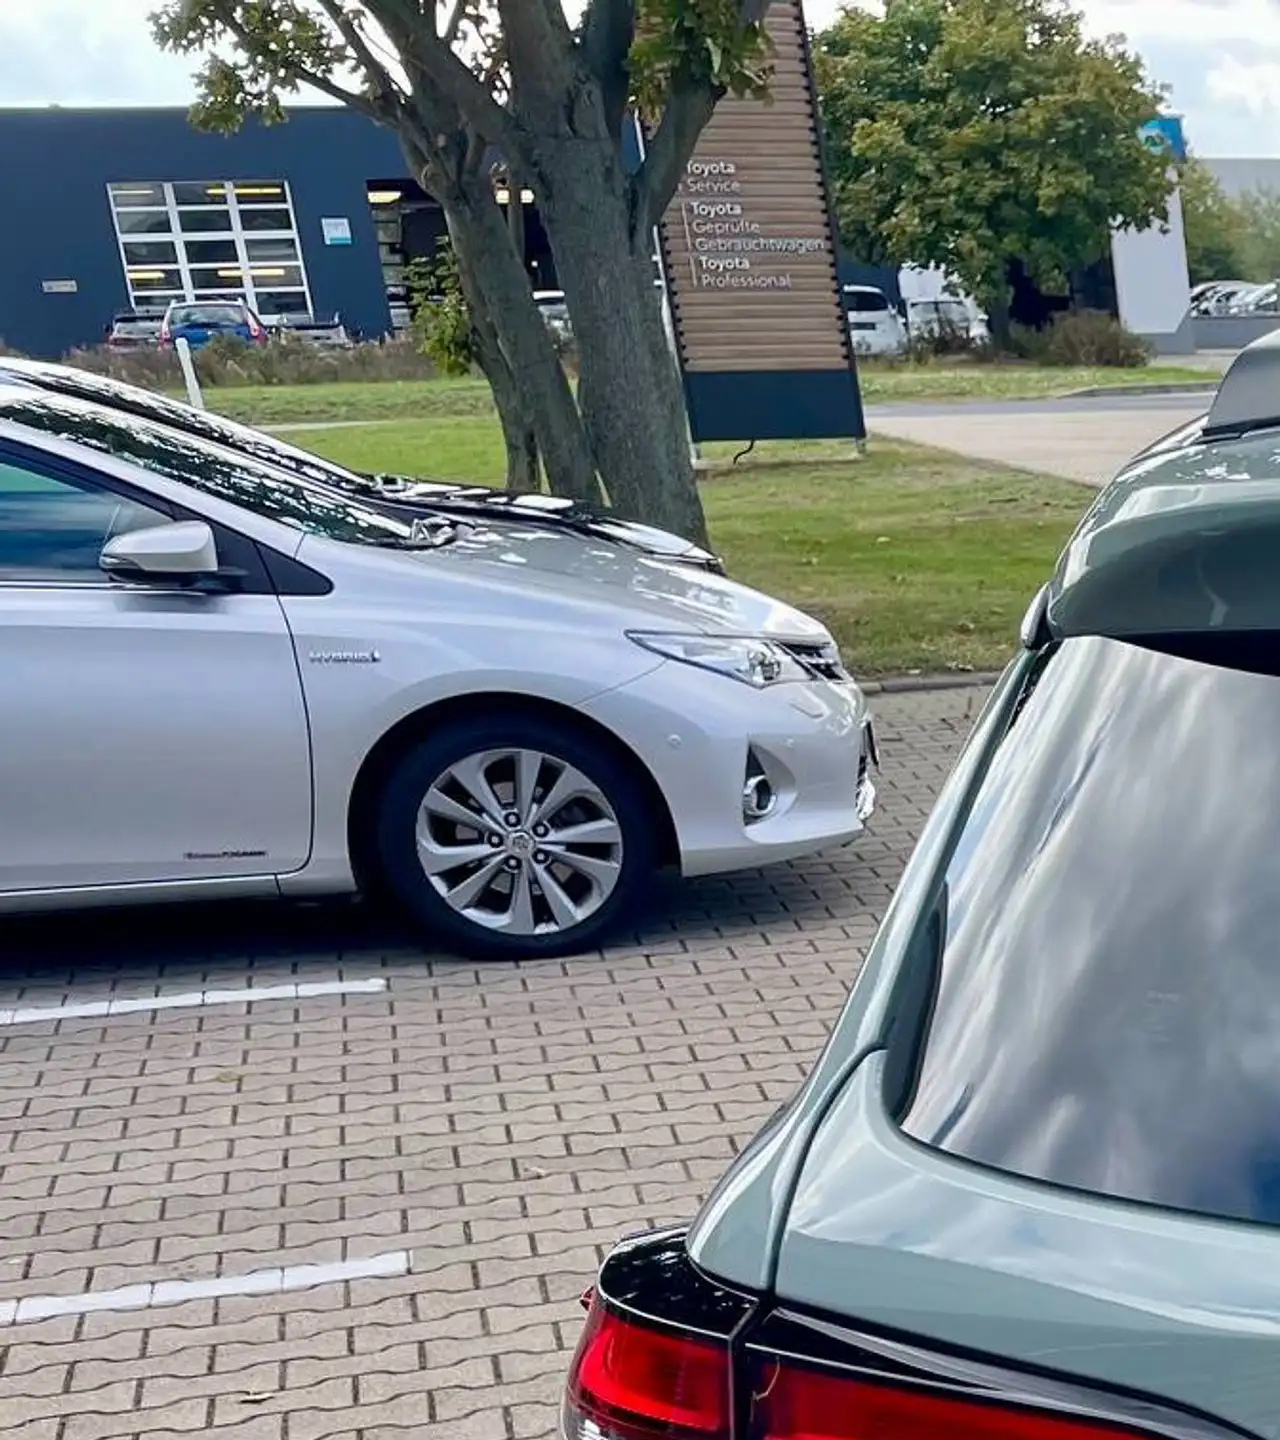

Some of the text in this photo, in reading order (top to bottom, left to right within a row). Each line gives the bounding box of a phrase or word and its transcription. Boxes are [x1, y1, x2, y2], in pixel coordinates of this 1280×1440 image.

[687, 178, 741, 192] Service
[690, 202, 742, 218] Toyota
[695, 238, 825, 253] Gebrauchtwagen
[700, 256, 750, 271] Toyota
[702, 273, 793, 288] Professional
